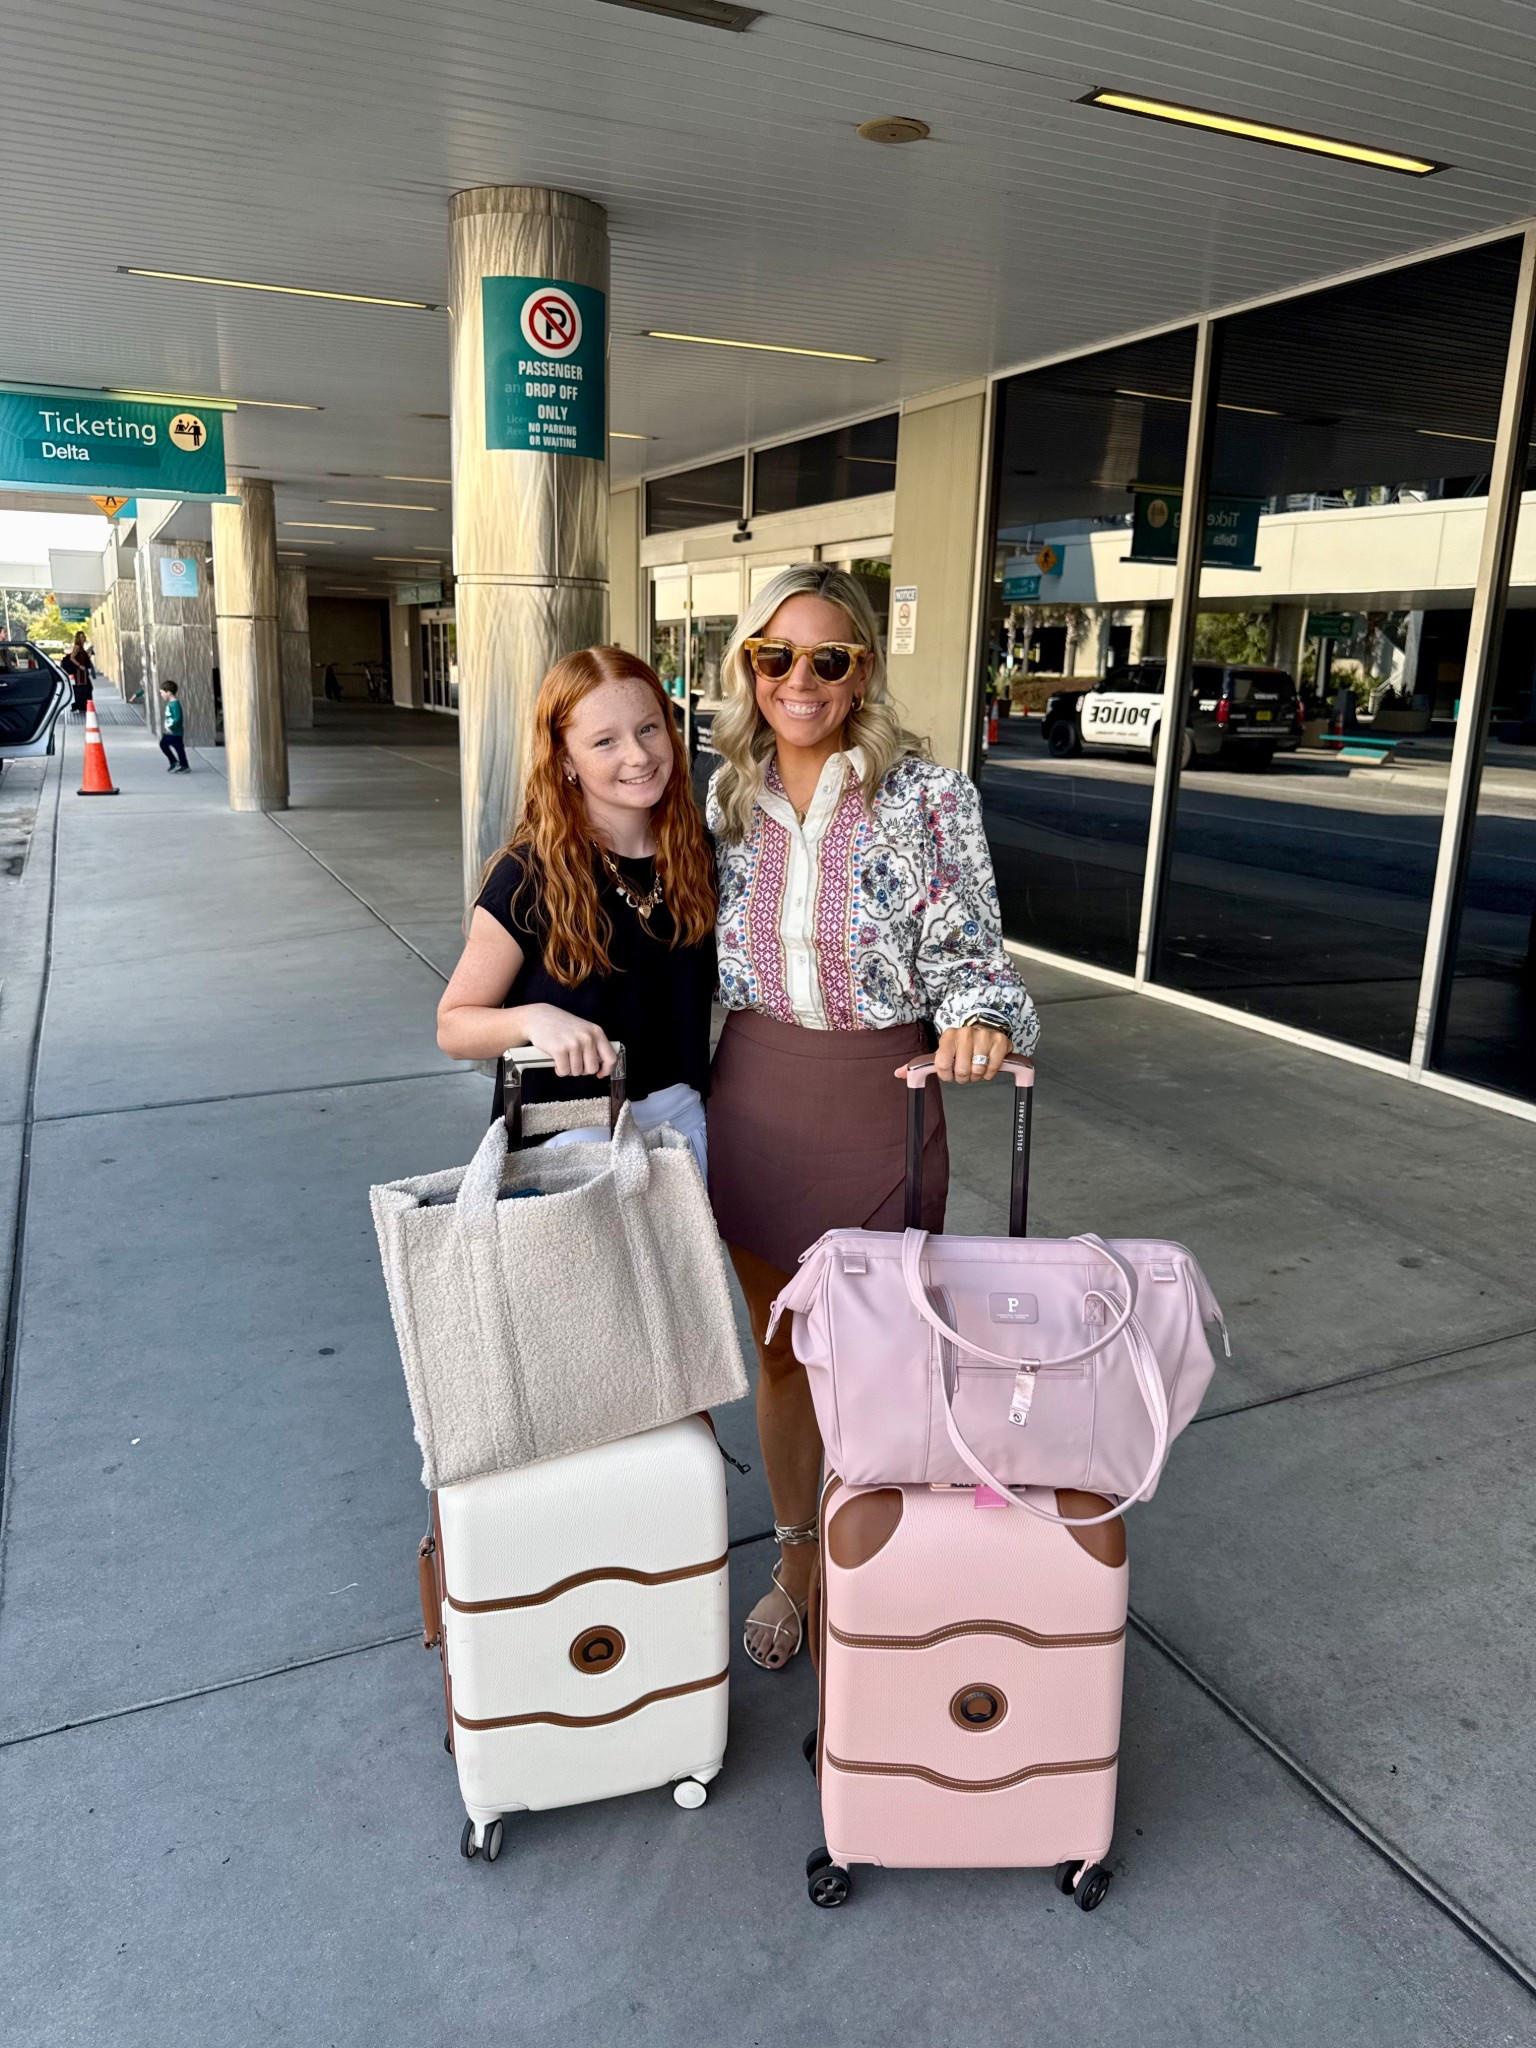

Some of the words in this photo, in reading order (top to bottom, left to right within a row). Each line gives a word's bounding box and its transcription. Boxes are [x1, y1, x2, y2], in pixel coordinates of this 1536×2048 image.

[518, 360, 583, 380] PASSENGER
[525, 382, 556, 398] DROP
[559, 385, 578, 401] OFF
[537, 404, 568, 421] ONLY
[39, 411, 157, 446] Ticketing
[528, 422, 541, 433] NO
[543, 423, 577, 436] PARKING
[42, 441, 90, 461] Delta
[529, 435, 541, 446] OR
[543, 436, 577, 449] WAITING
[895, 589, 916, 601] NOTICE
[1016, 1125, 1024, 1151] DELSEY
